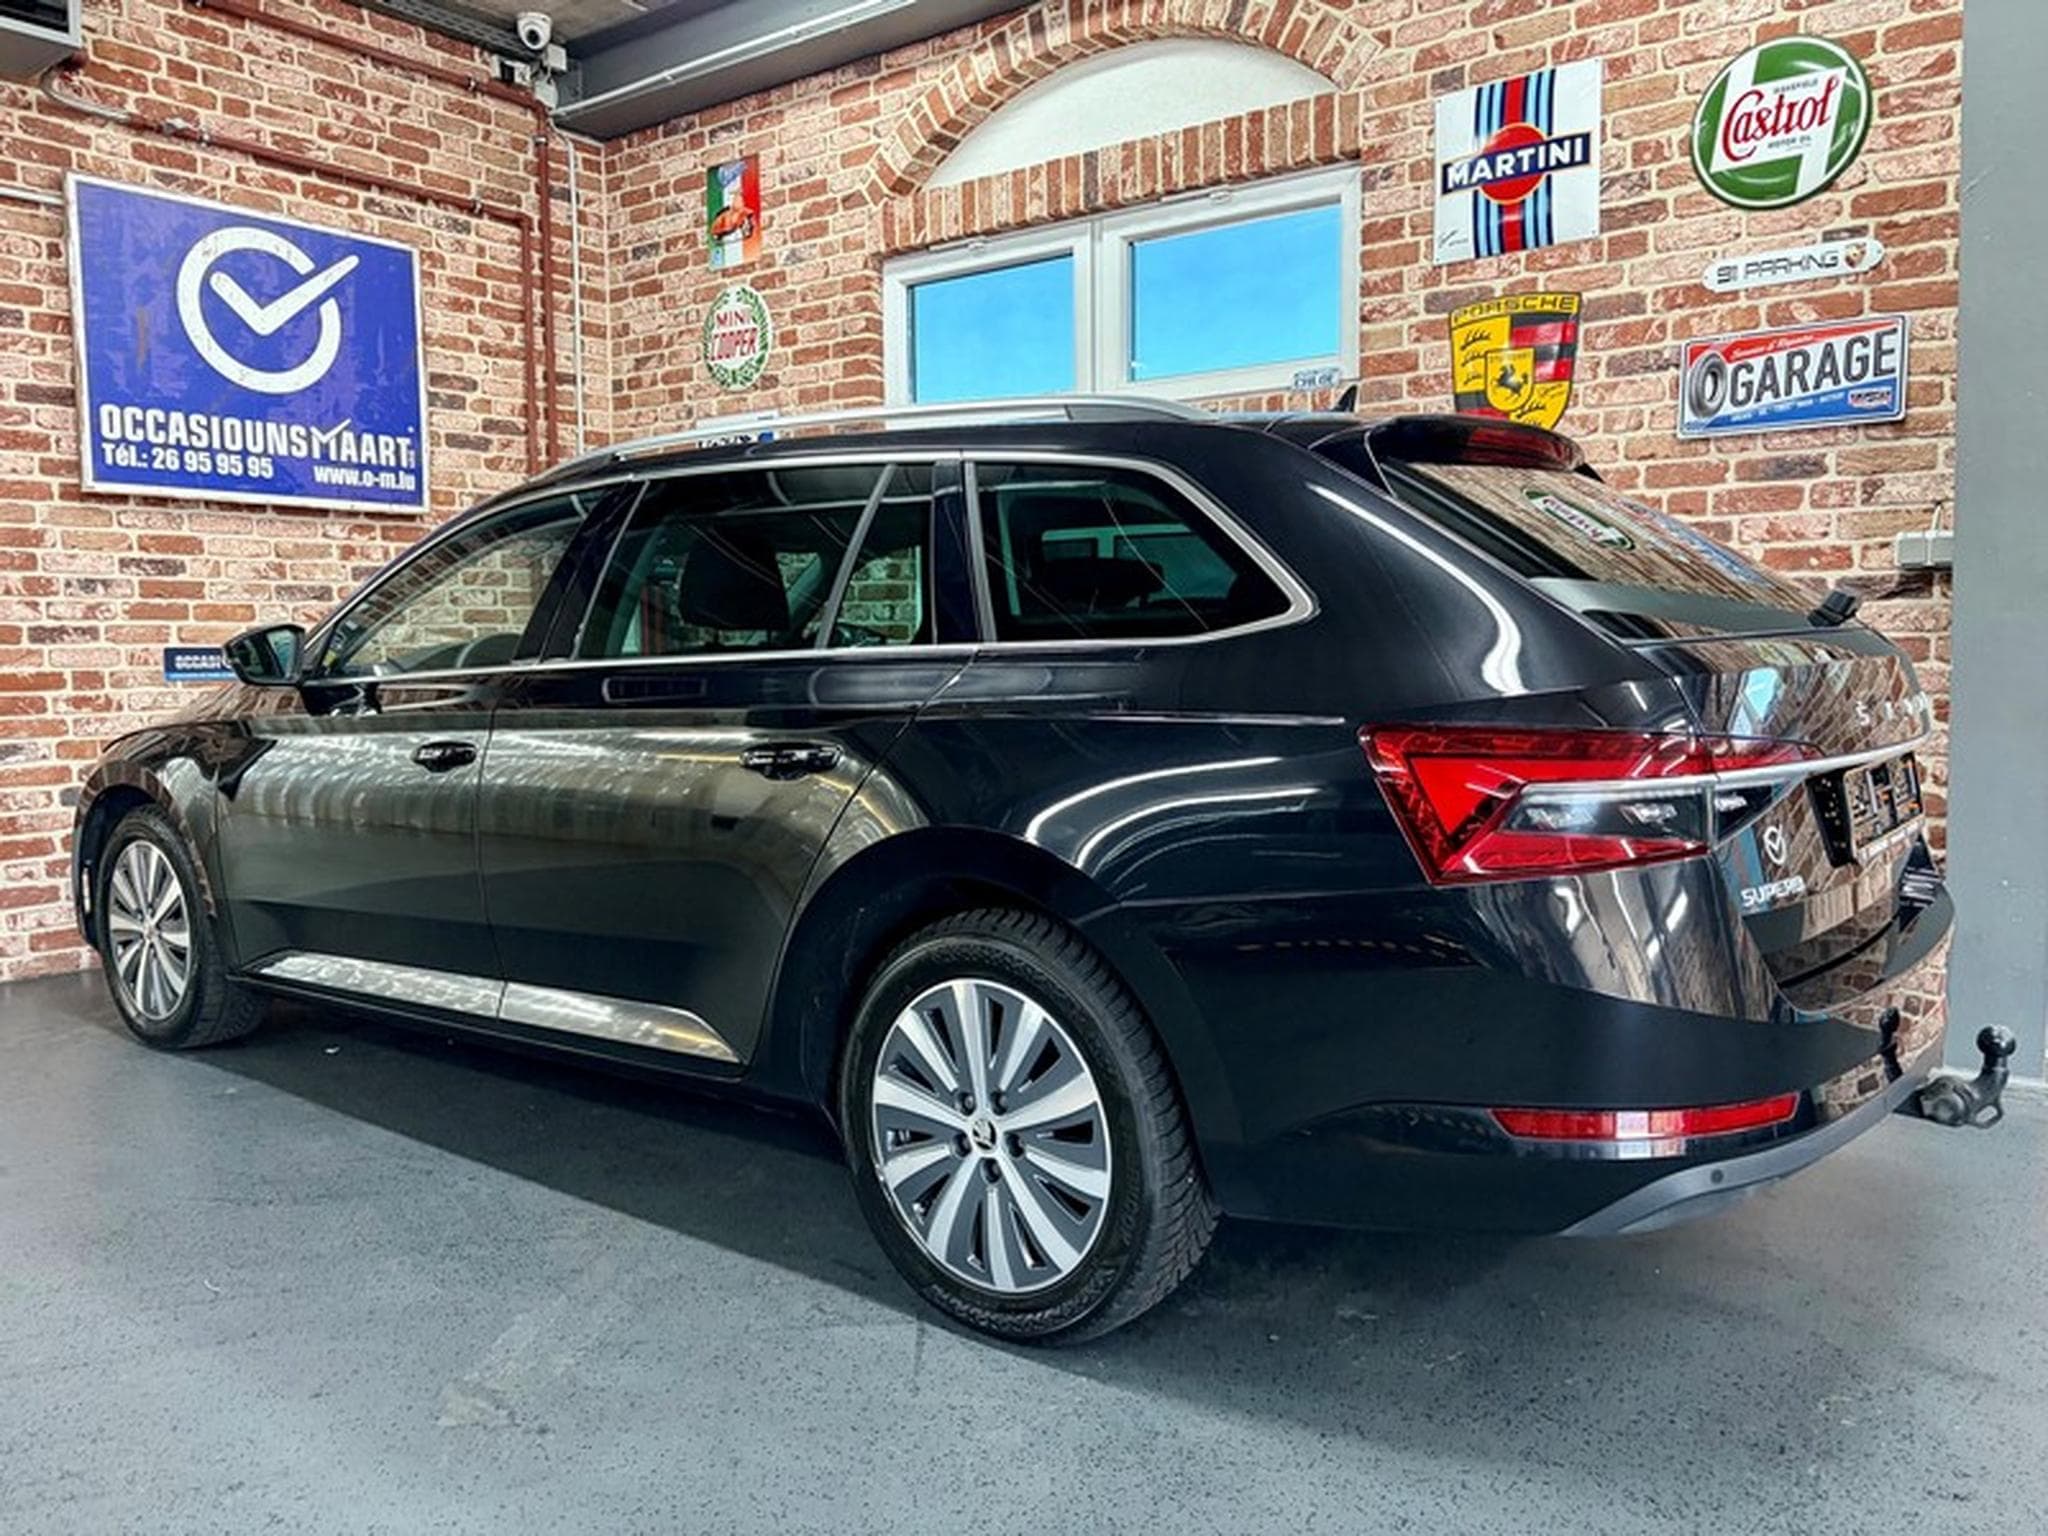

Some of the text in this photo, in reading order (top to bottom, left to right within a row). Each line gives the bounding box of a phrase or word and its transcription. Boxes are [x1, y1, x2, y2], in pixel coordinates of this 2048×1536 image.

[1722, 74, 1840, 162] Castrol
[1447, 137, 1584, 190] MARTINI
[1744, 249, 1840, 279] PARKING
[715, 308, 752, 329] MINI
[1454, 295, 1577, 325] PORSCHE
[710, 326, 758, 362] COOPER
[1730, 327, 1899, 408] GARAGE
[100, 403, 411, 468] OCCASIOUNSMAART
[152, 447, 180, 471] 26
[184, 451, 212, 473] 95
[216, 453, 243, 477] 95
[247, 456, 274, 480] 95
[313, 465, 416, 491] www.o-m.lu
[1741, 875, 1806, 908] SUPERB
